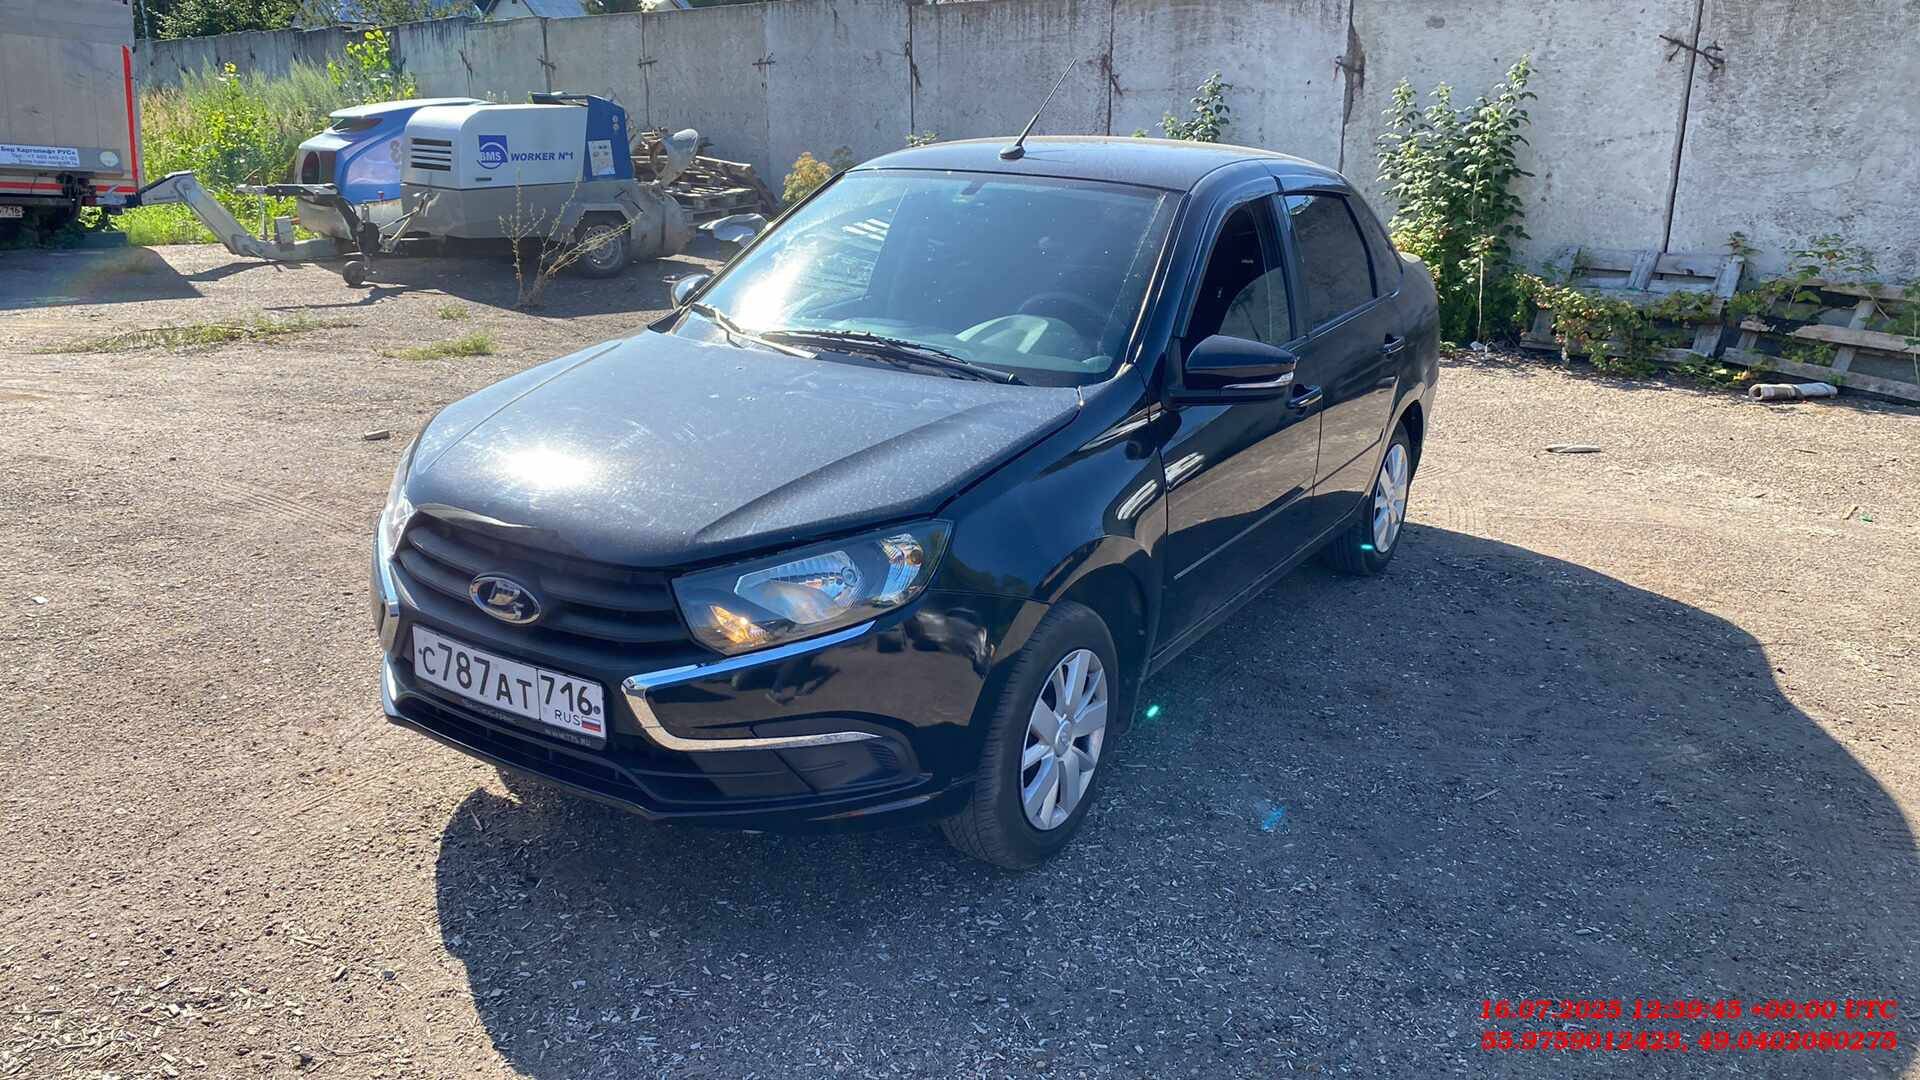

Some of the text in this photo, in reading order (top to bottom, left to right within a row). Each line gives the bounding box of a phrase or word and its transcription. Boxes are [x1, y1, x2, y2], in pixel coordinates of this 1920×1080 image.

[479, 151, 502, 161] BMS
[510, 152, 556, 161] WORKER
[422, 642, 593, 716] C787AT 716
[554, 709, 581, 726] RUS
